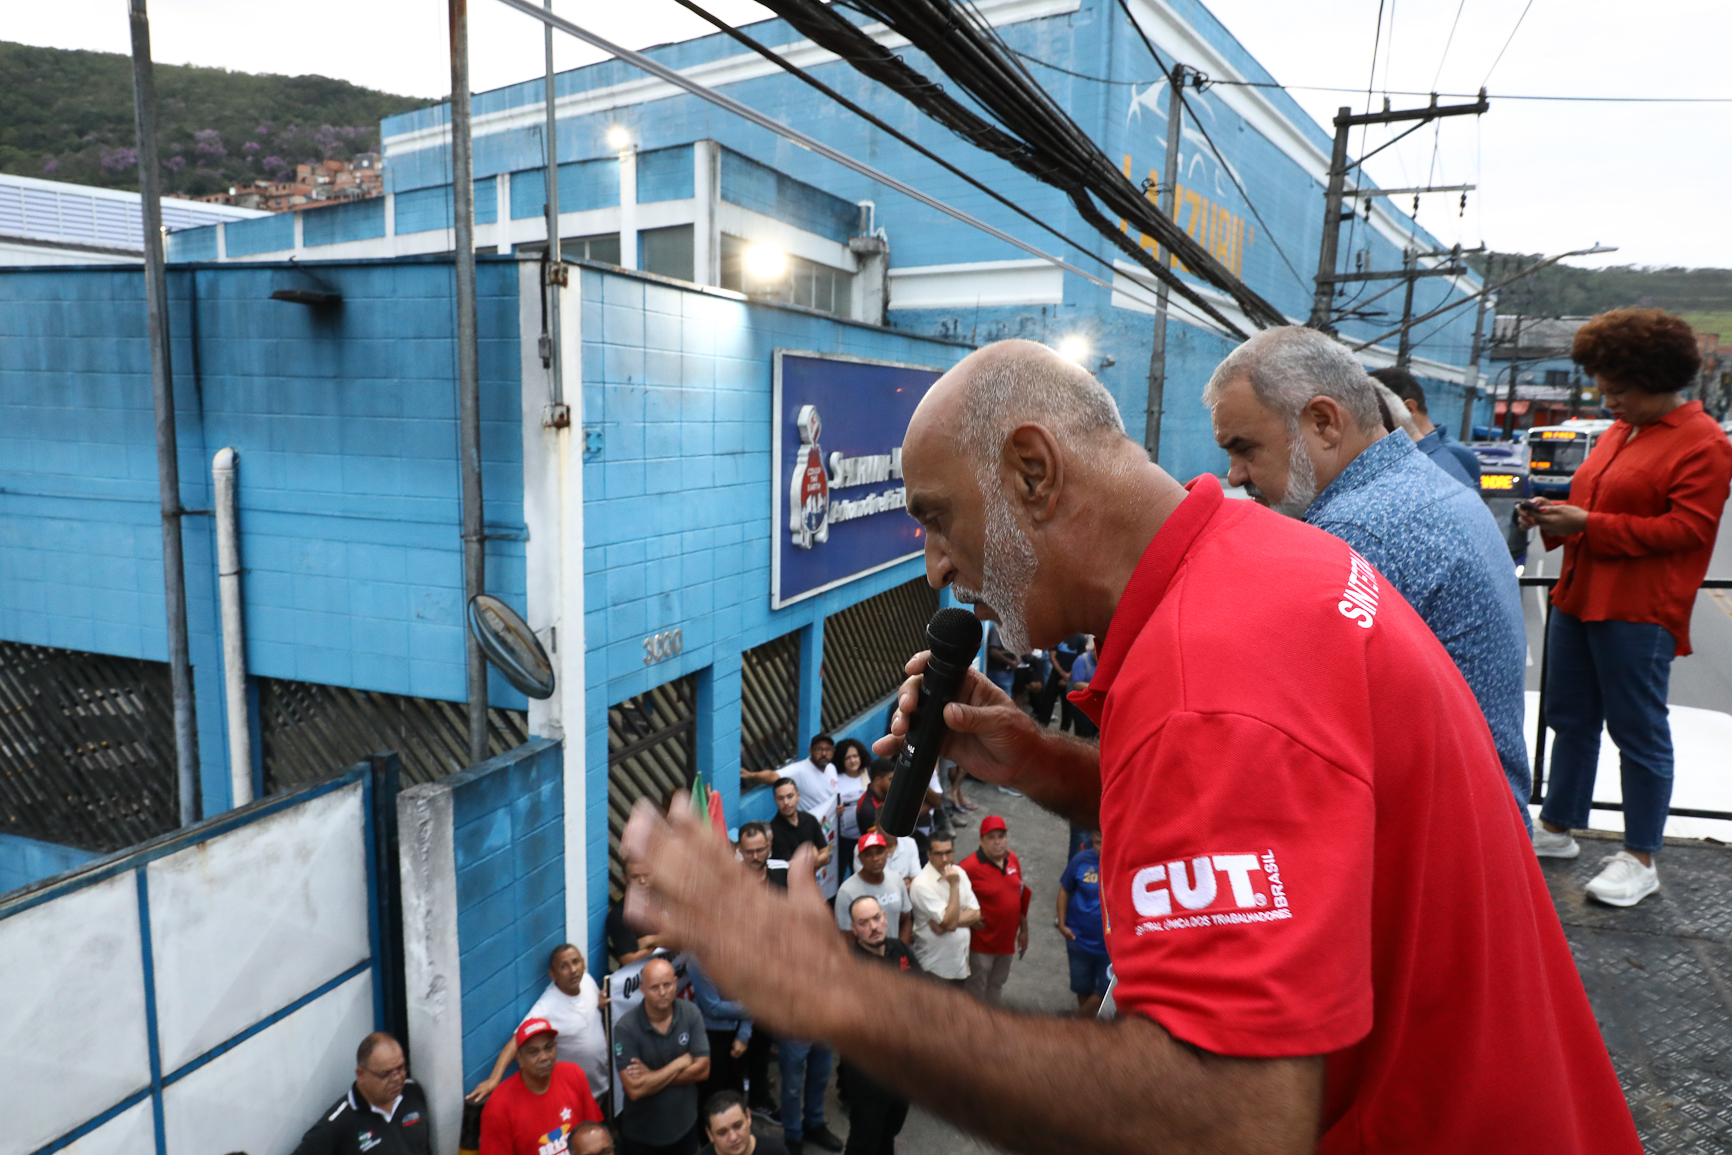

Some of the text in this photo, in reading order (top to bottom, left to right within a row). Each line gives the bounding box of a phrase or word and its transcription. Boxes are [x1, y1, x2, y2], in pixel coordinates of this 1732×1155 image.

[643, 629, 683, 664] 3000
[1132, 854, 1261, 917] CUT
[1261, 849, 1289, 908] BRASIL
[1190, 915, 1212, 928] DOS
[1210, 908, 1293, 926] TRABALHADORES
